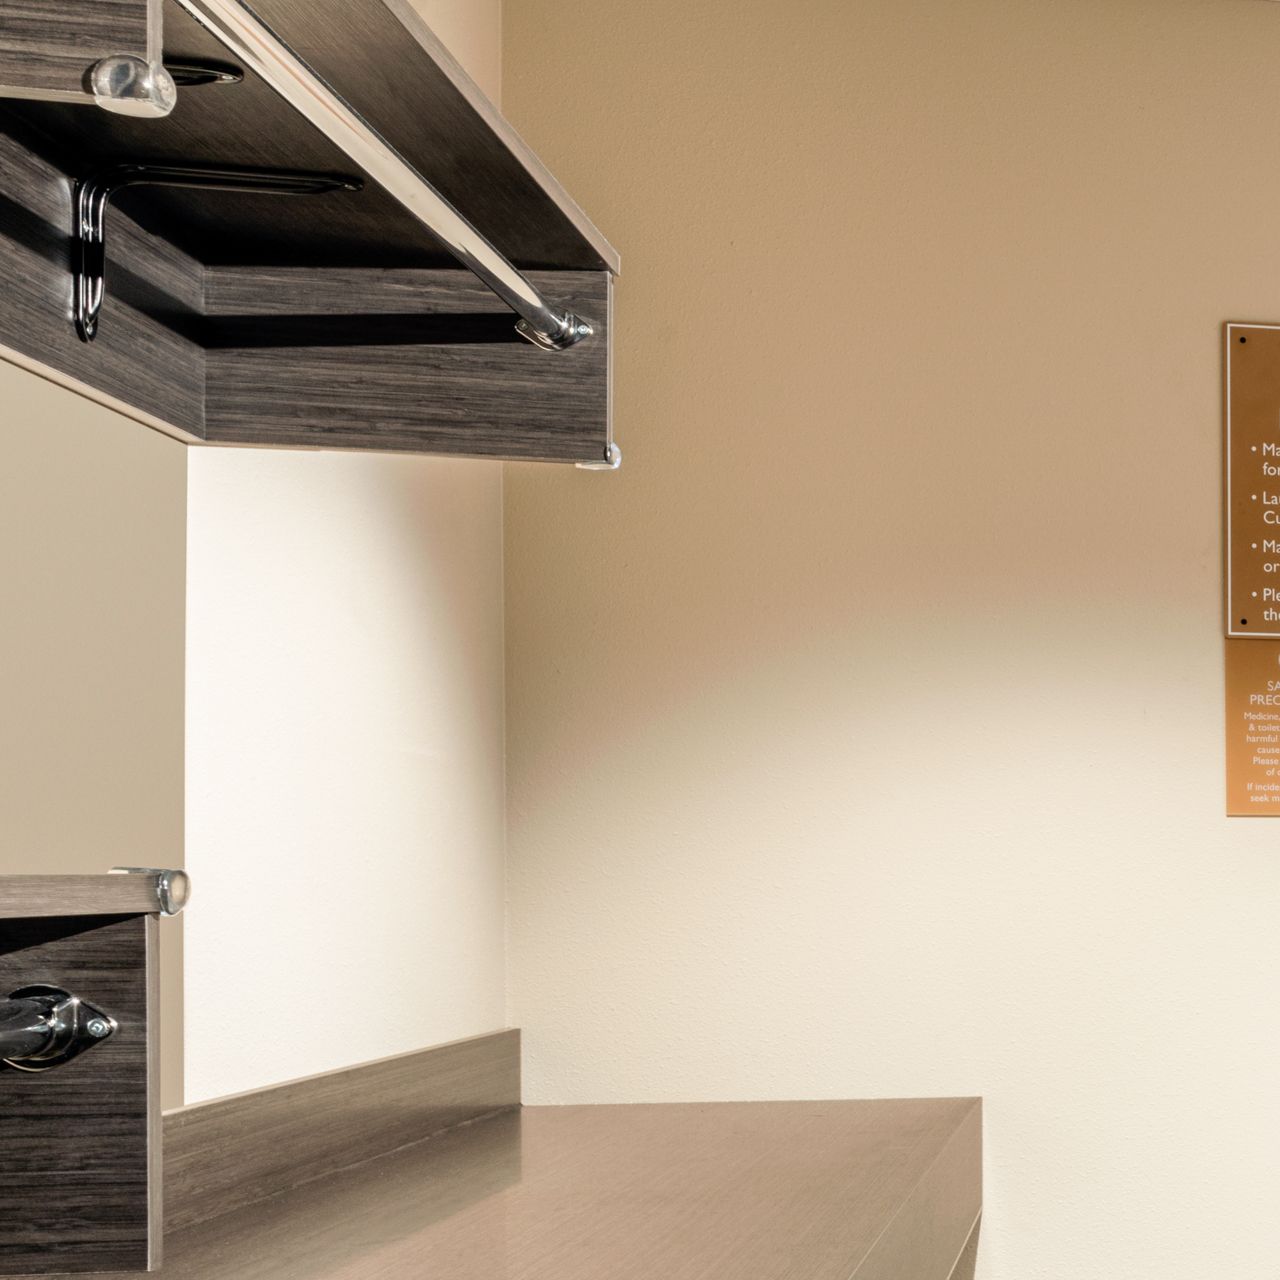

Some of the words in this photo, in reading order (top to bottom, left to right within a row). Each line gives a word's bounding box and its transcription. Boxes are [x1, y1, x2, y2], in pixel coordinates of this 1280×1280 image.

[1263, 563, 1280, 572] or
[1248, 723, 1256, 732] &
[1246, 734, 1278, 743] harmful
[1253, 756, 1279, 765] Please
[1266, 768, 1275, 776] of
[1247, 783, 1253, 791] If
[1250, 794, 1269, 802] seek
